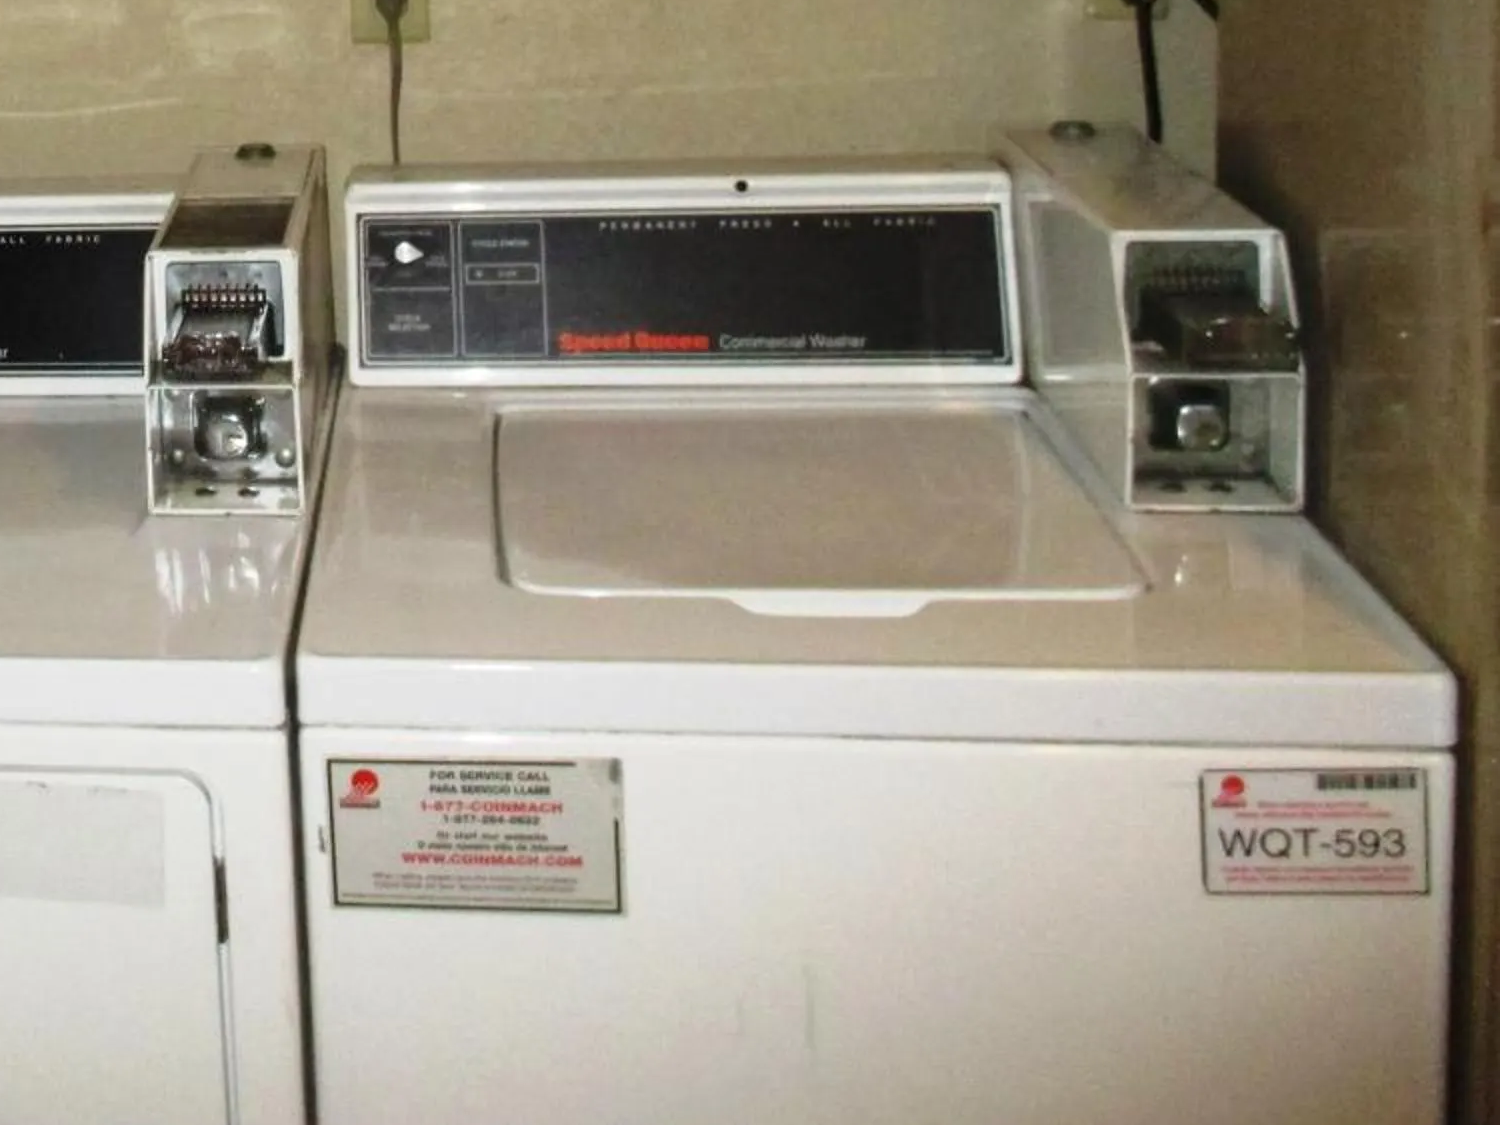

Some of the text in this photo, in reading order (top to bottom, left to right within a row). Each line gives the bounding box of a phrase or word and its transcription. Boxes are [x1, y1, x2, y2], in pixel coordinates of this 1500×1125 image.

[0, 235, 27, 245] ALL
[558, 332, 867, 353] Speed Queen Commercial Washer
[429, 770, 550, 781] FOR SERVICE CALL
[419, 799, 564, 814] 1-877-COINMACH
[1217, 827, 1407, 859] WQT-593
[401, 852, 583, 868] WWW.COINMACH.COM
